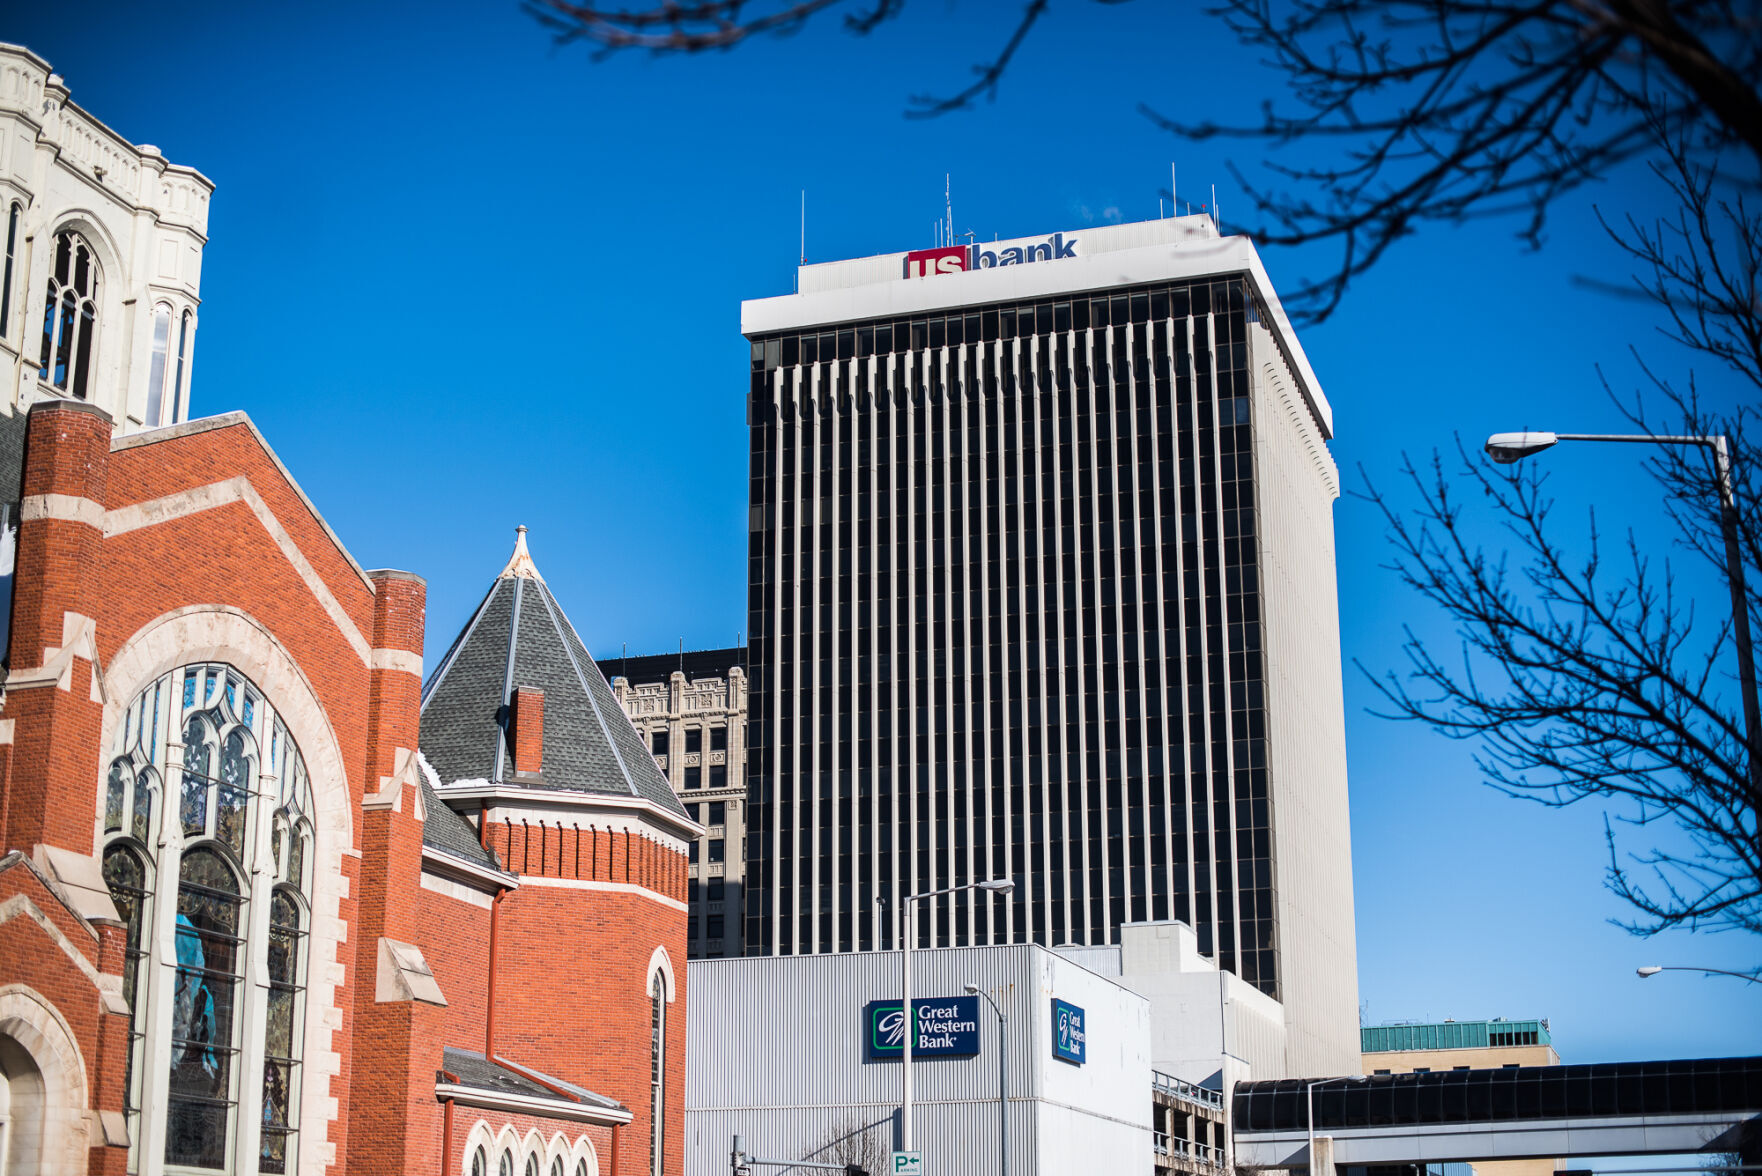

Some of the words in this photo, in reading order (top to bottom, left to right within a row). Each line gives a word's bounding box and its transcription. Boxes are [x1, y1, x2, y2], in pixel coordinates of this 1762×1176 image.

[919, 1005, 958, 1019] Great
[1070, 1011, 1080, 1027] Great
[918, 1020, 975, 1034] Western
[1070, 1025, 1085, 1042] Western
[919, 1033, 954, 1048] Bank
[1070, 1039, 1080, 1055] Bank
